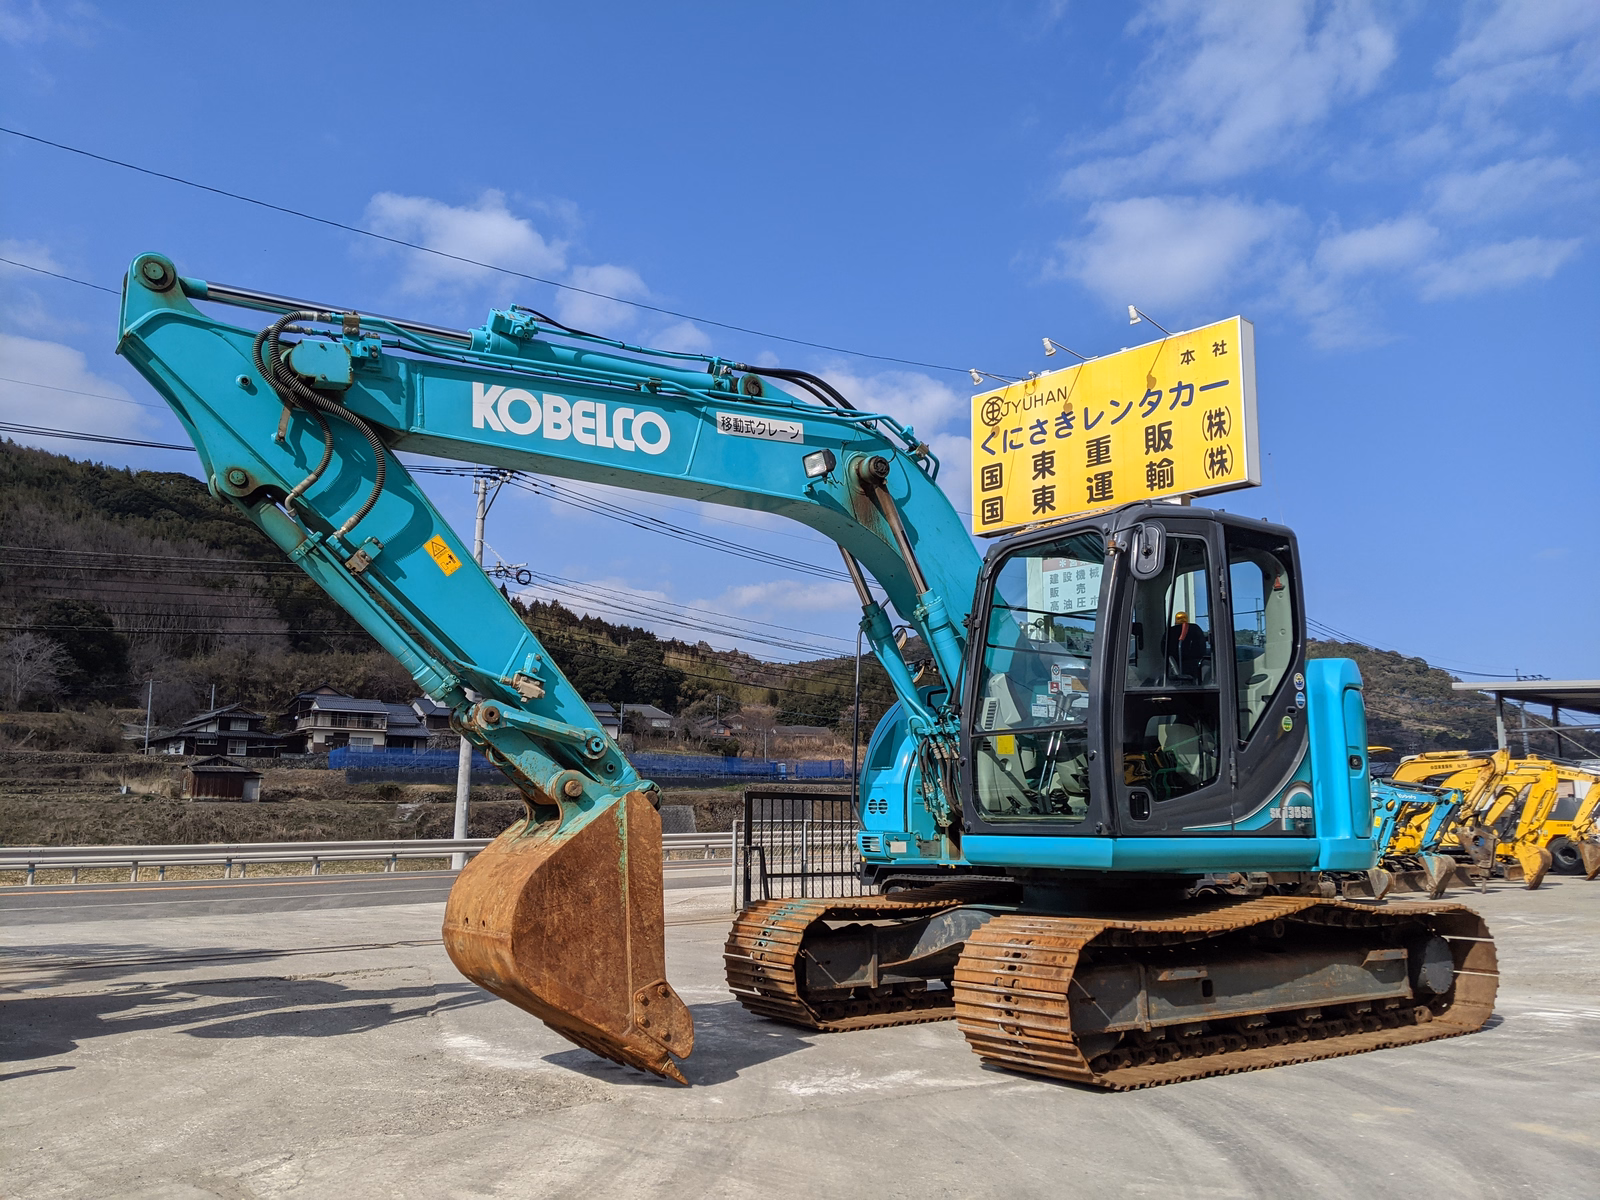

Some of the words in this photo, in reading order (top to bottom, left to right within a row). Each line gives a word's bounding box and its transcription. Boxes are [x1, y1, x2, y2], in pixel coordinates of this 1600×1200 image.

[1180, 340, 1228, 365] 本社
[1000, 386, 1067, 417] JYUHAN
[472, 381, 671, 455] KOBELCO
[720, 416, 800, 440] 移動式クレーン
[980, 379, 1230, 456] くにさきレンタカー
